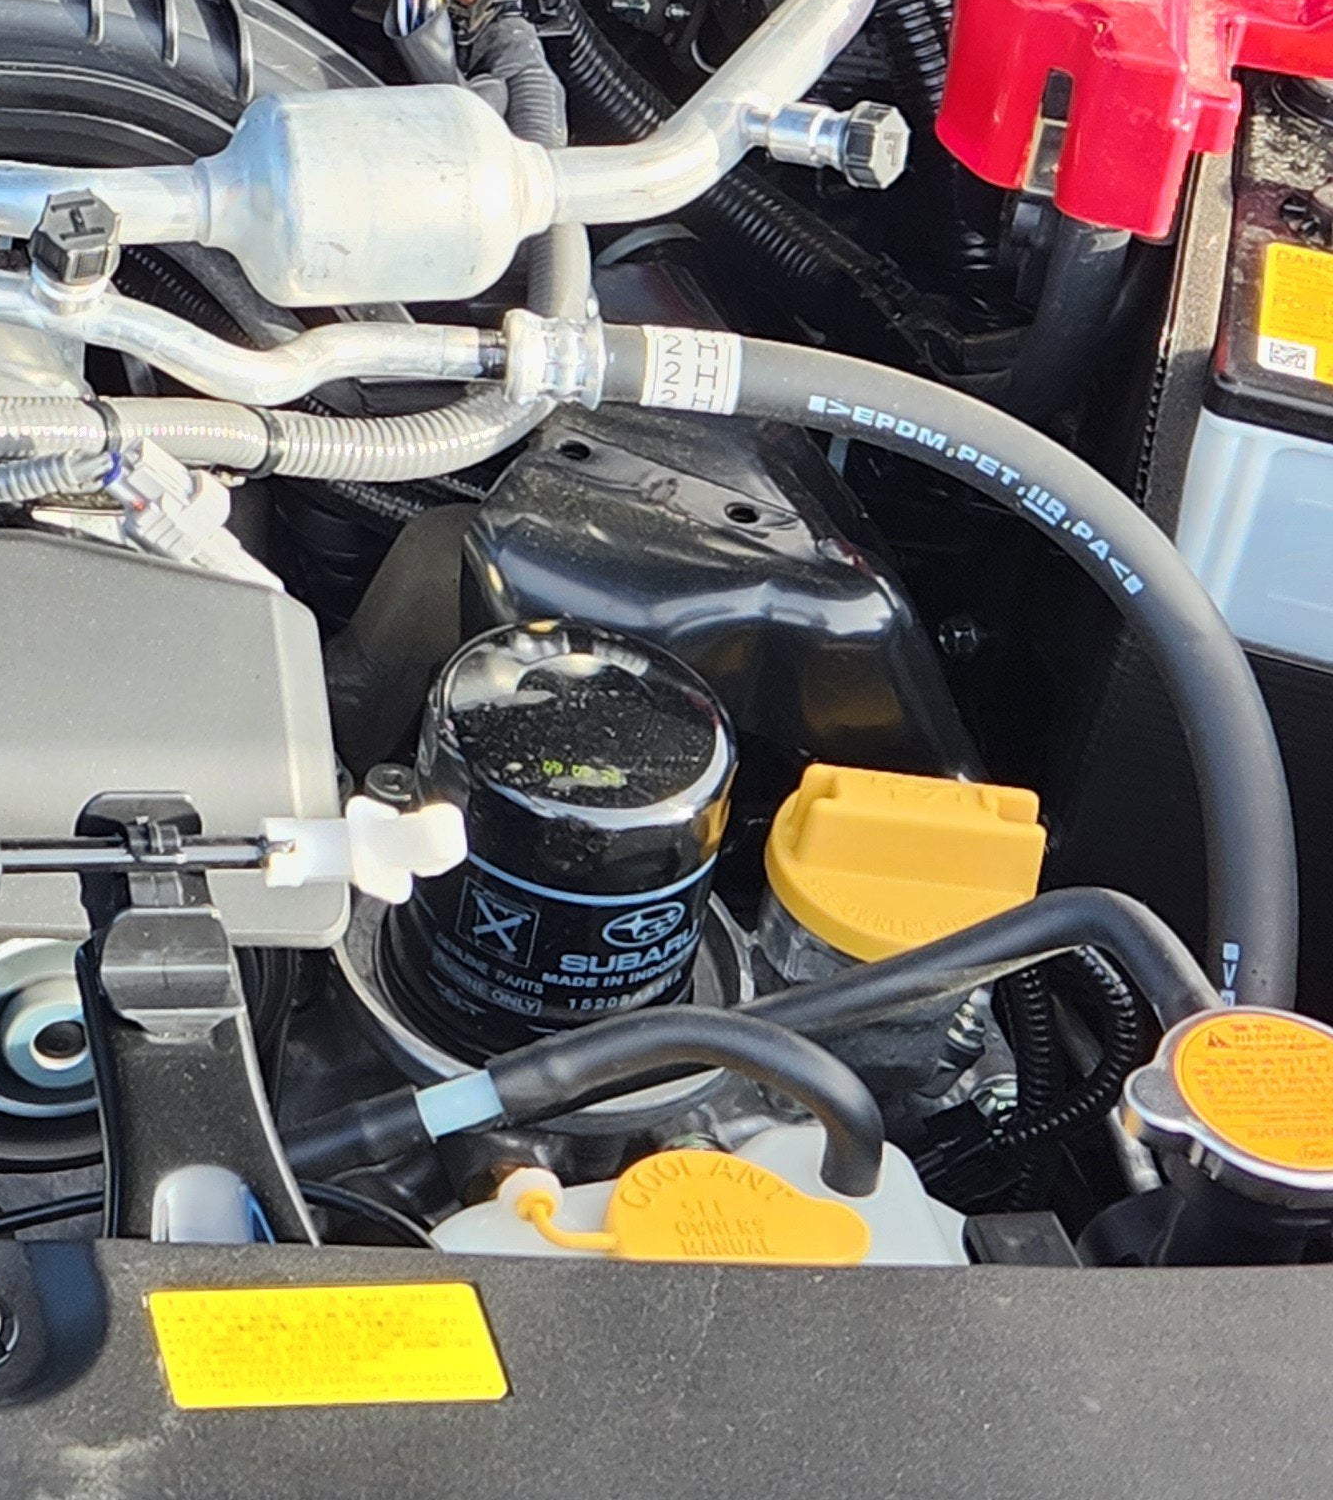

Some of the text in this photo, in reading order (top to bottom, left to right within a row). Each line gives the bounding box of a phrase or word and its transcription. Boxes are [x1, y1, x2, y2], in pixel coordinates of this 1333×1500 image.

[663, 361, 719, 389] 2 H
[559, 918, 700, 974] SUBARU
[495, 968, 544, 995] PARTS
[541, 972, 600, 988] MADE
[602, 974, 625, 988] IN
[491, 987, 538, 1014] ONLY
